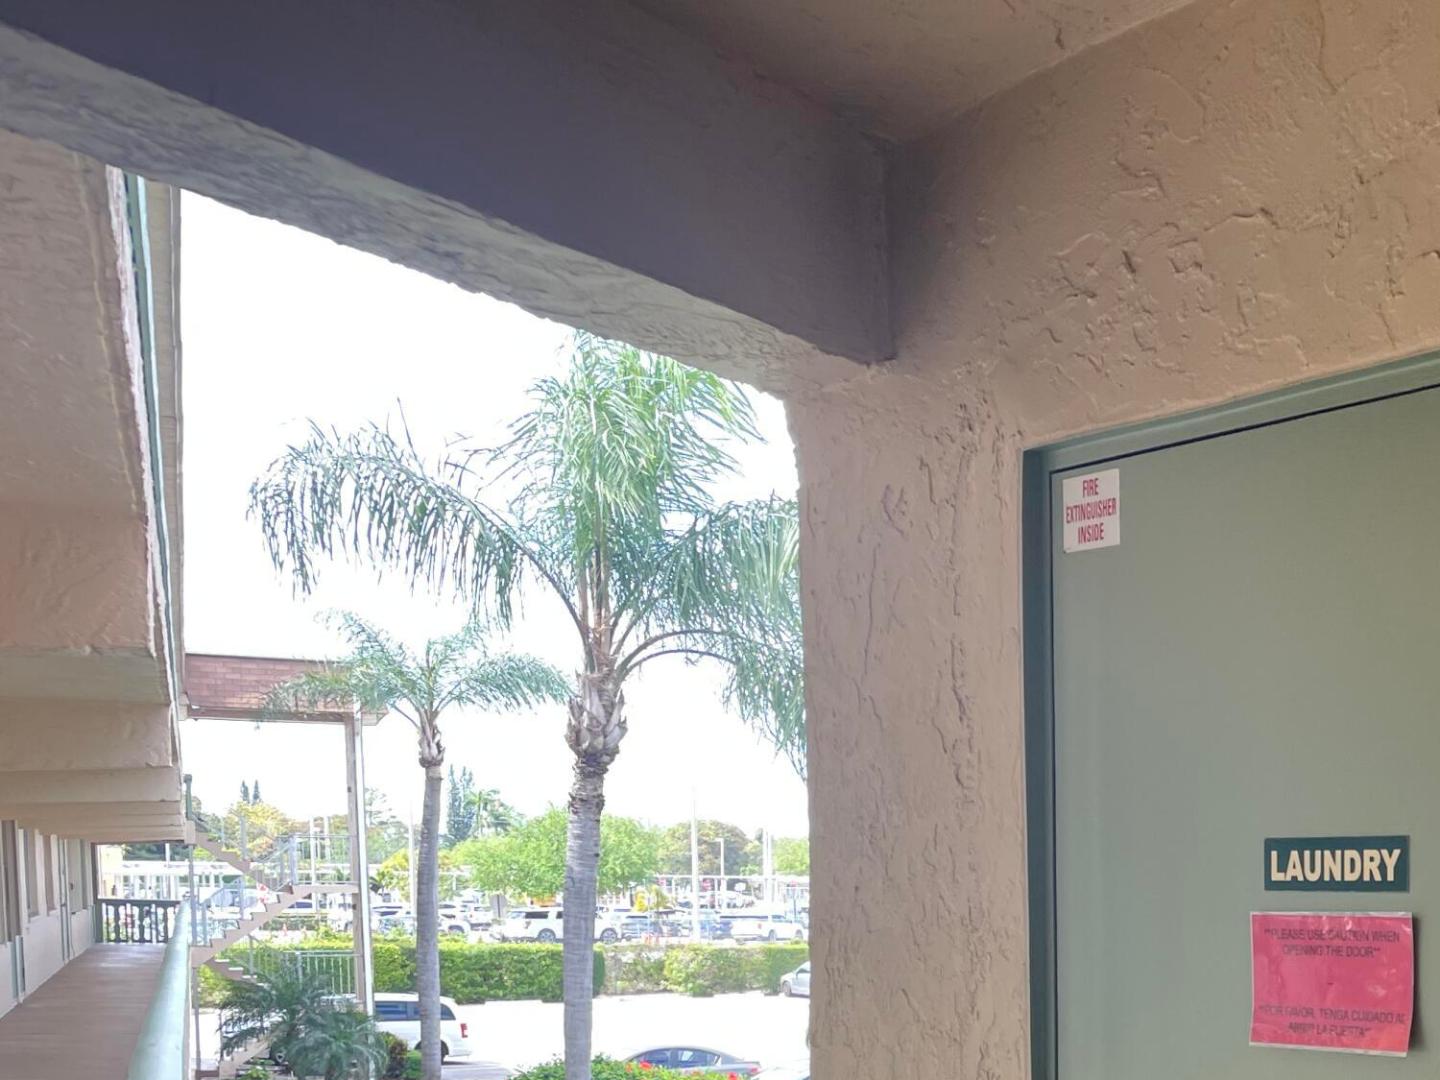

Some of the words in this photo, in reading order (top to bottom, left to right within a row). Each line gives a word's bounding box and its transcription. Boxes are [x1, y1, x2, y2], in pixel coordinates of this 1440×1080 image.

[1083, 478, 1099, 497] FIRE
[1066, 498, 1117, 524] EXTINGUISHER
[1078, 523, 1104, 544] INSIDE
[1271, 849, 1400, 882] LAUNDRY
[1371, 930, 1400, 942] WHEN
[1325, 945, 1343, 956] THE
